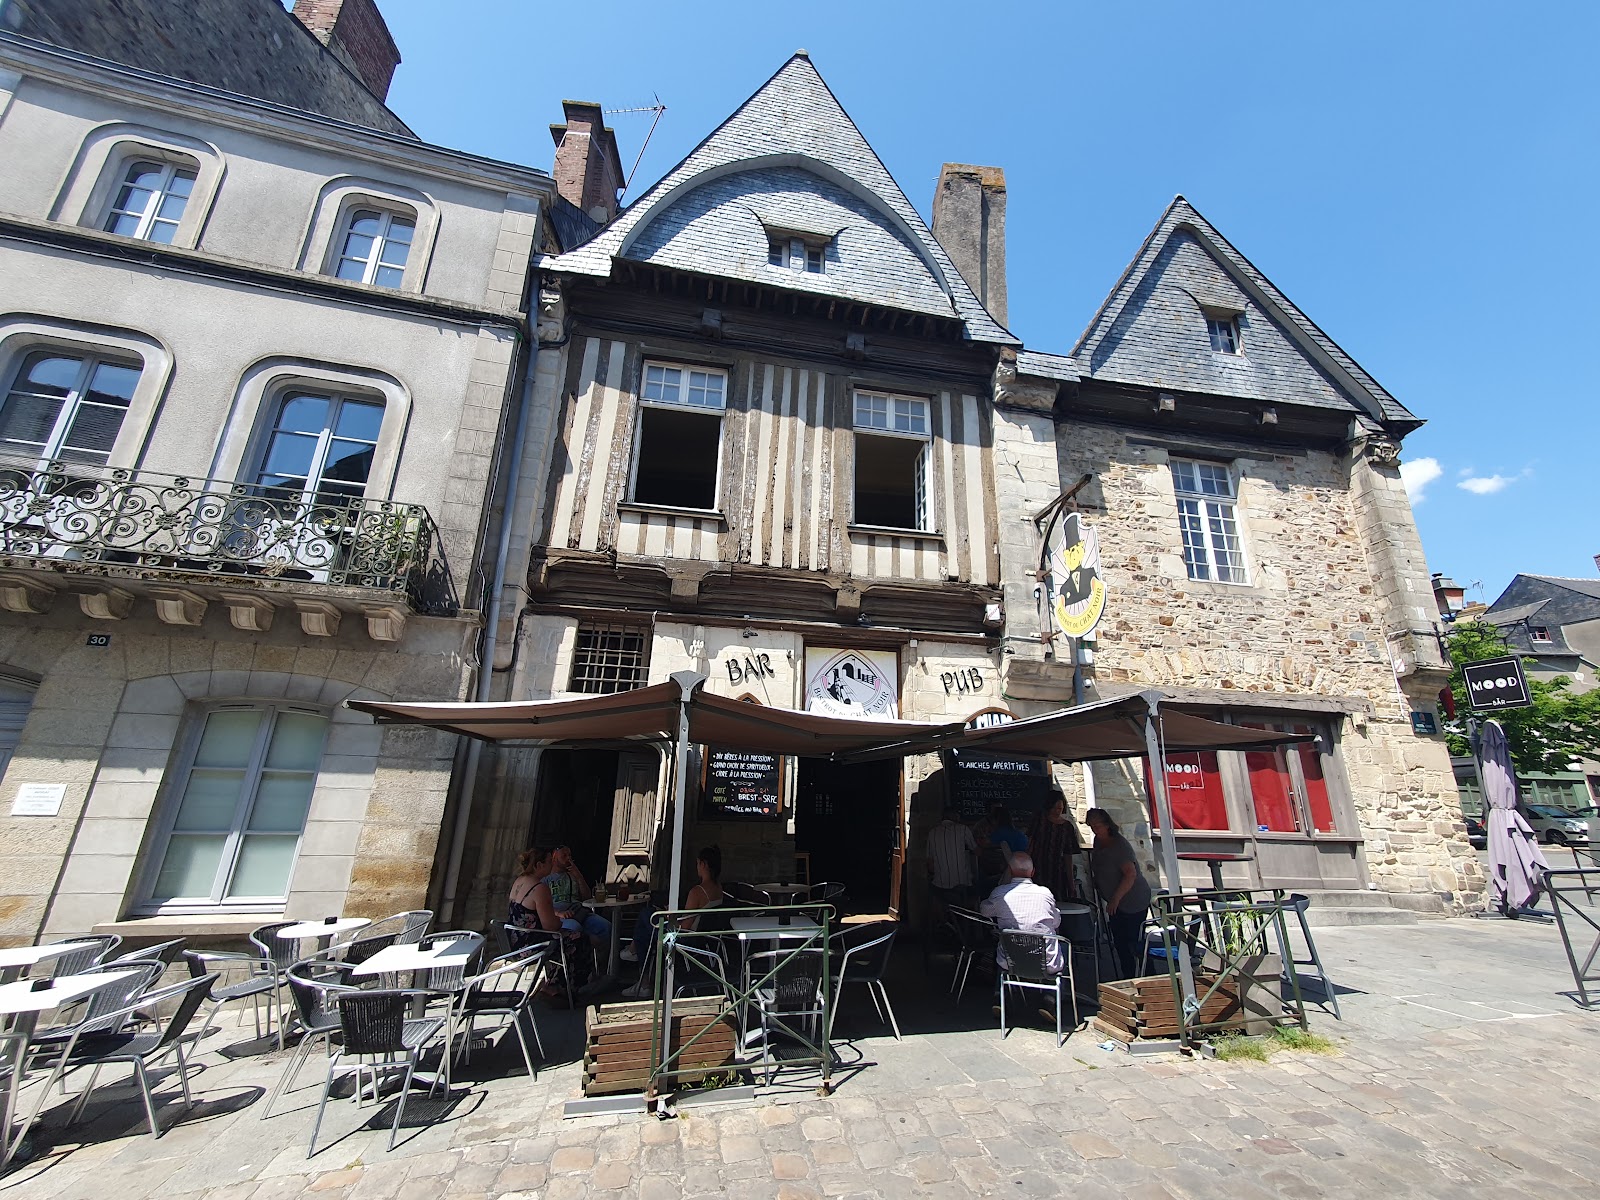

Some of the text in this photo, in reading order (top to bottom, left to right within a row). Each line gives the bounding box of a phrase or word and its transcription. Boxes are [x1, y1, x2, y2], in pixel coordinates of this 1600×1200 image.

[1080, 610, 1094, 627] CHAT
[1093, 588, 1102, 609] NOIR
[90, 636, 107, 645] 30
[725, 653, 774, 682] BAR
[940, 667, 983, 694] PUB
[1471, 676, 1517, 691] MOOD
[872, 690, 890, 710] NOIR
[1492, 697, 1506, 706] BAR
[958, 761, 990, 770] PLANCHES
[1166, 763, 1199, 774] MOOD
[737, 793, 758, 801] BREST
